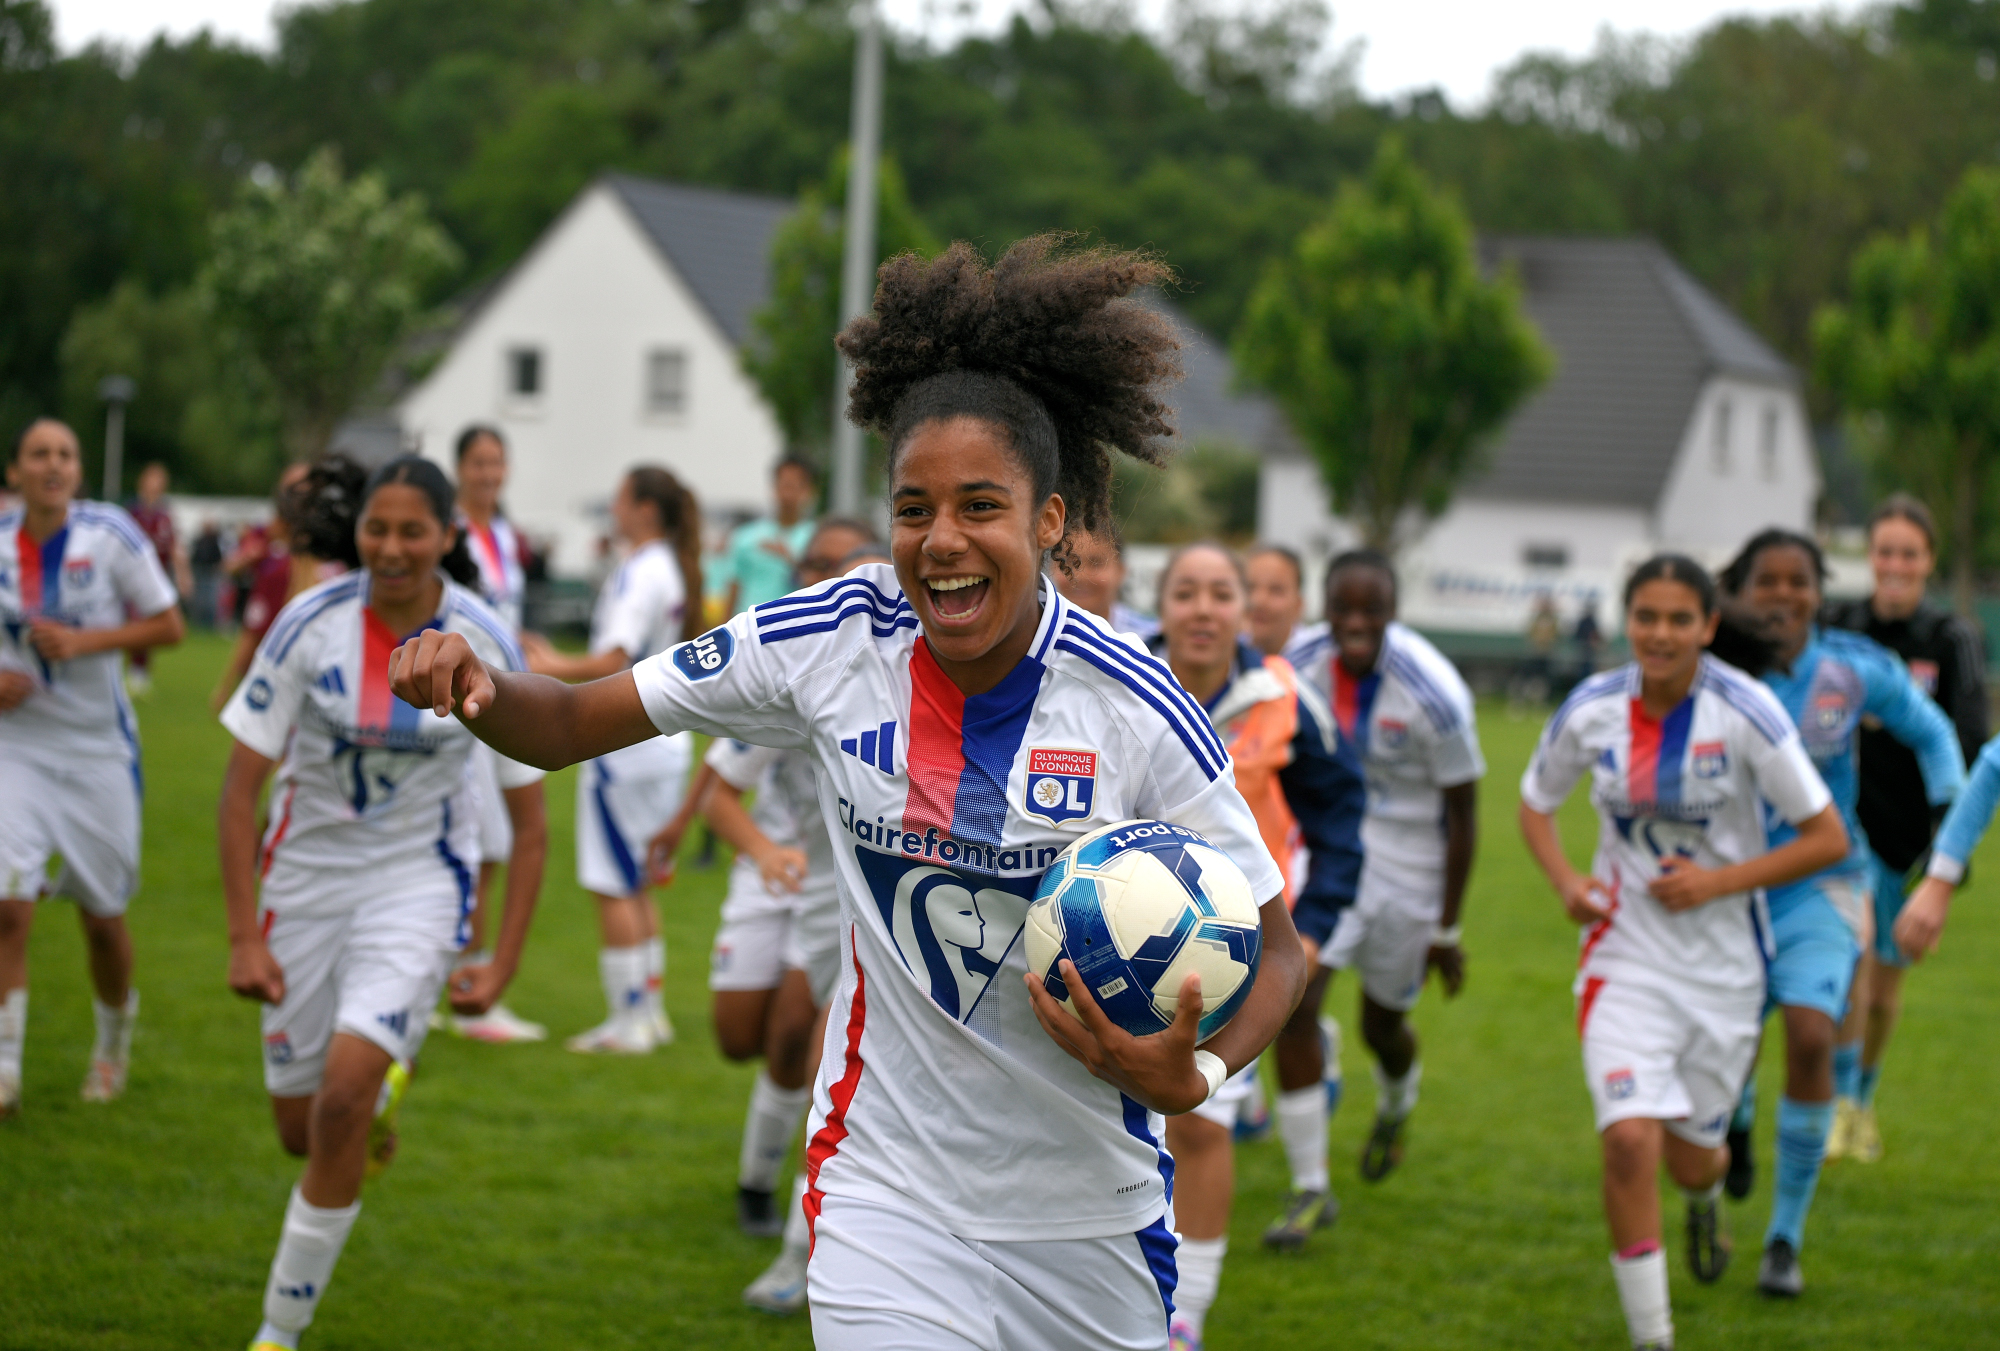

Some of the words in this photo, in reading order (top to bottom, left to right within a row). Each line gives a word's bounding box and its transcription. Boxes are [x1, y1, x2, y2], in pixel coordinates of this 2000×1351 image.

[692, 636, 722, 670] U19
[1034, 752, 1092, 764] OLYMPIQUE
[1034, 761, 1092, 774] LYONNAIS
[1032, 777, 1086, 811] OL
[838, 797, 1058, 871] Clairefontain
[1116, 1179, 1149, 1195] AEROREADY
